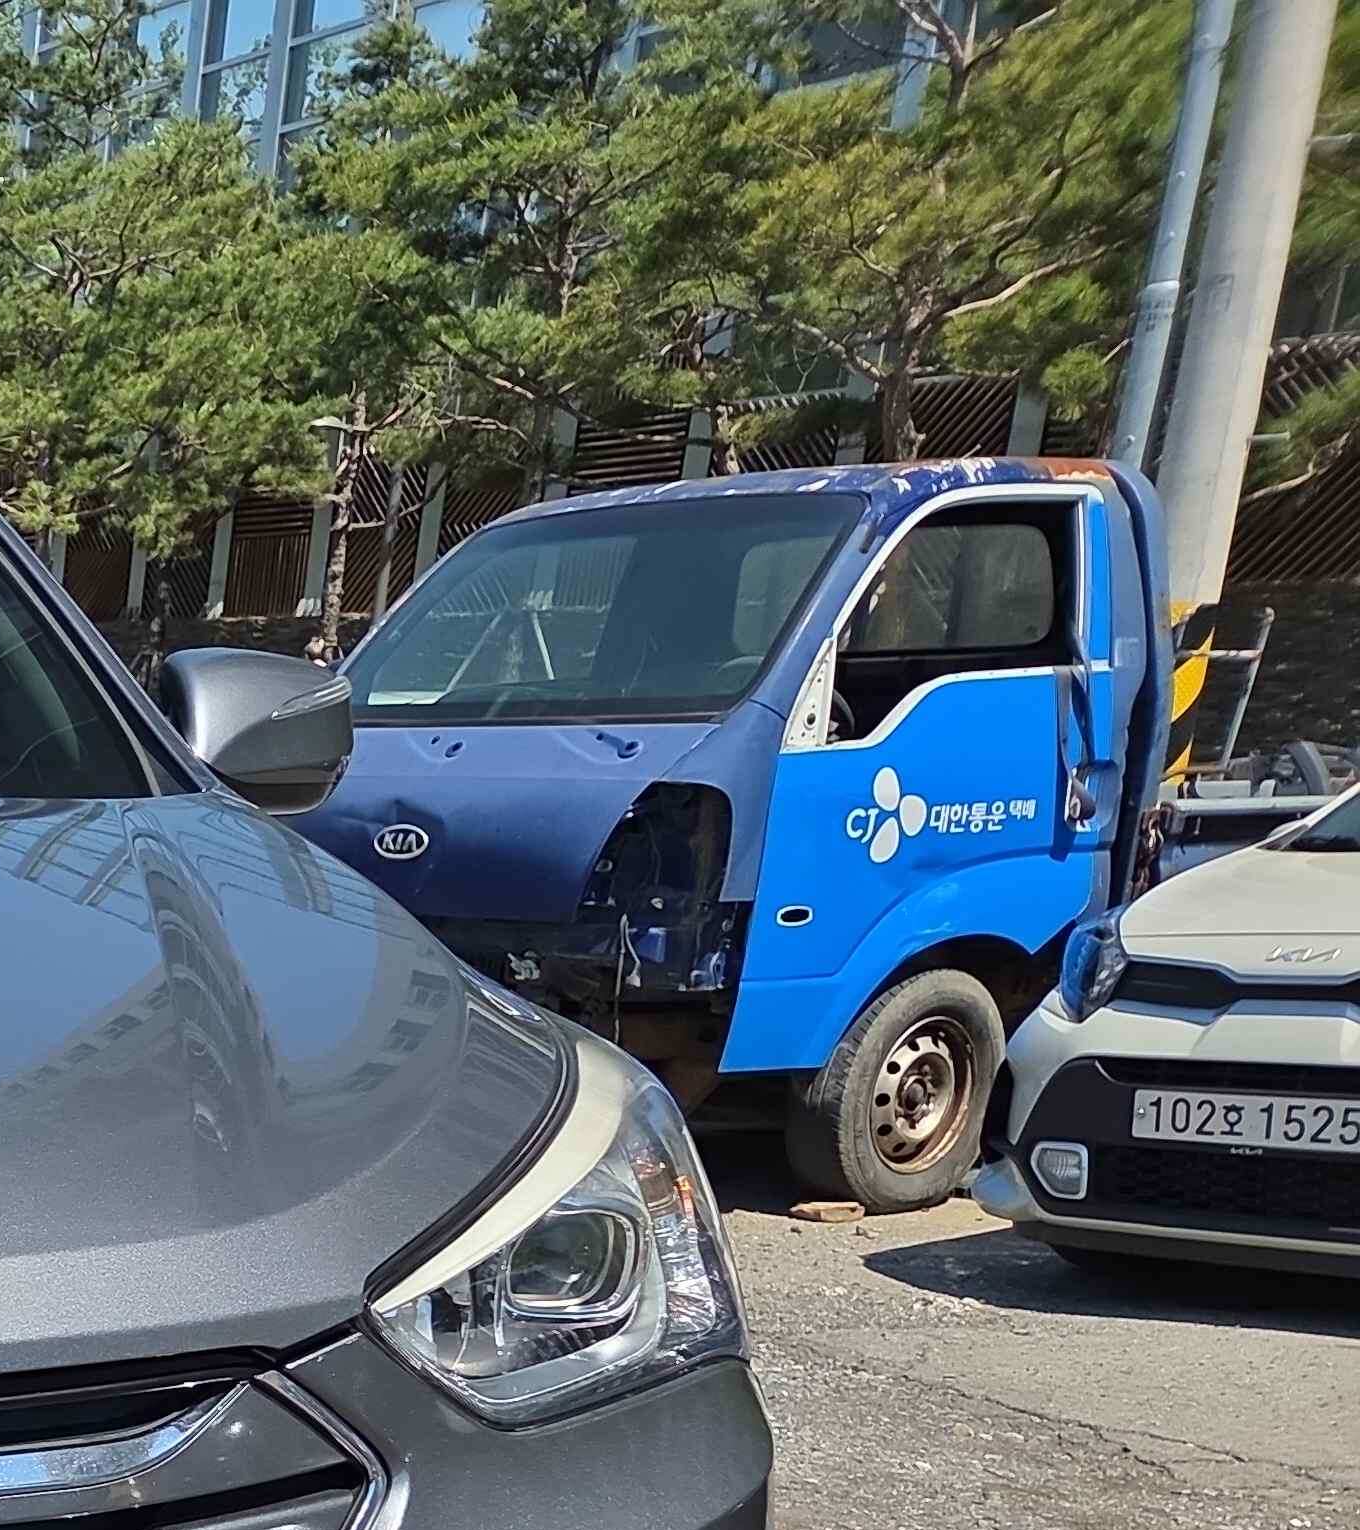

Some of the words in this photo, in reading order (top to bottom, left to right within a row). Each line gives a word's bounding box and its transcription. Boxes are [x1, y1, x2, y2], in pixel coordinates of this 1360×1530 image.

[382, 832, 417, 851] KIA
[846, 807, 880, 843] CJ
[930, 801, 1007, 833] 대한통운
[1009, 799, 1037, 819] 택배
[1149, 1096, 1245, 1137] 102호
[1259, 1102, 1360, 1145] 1525
